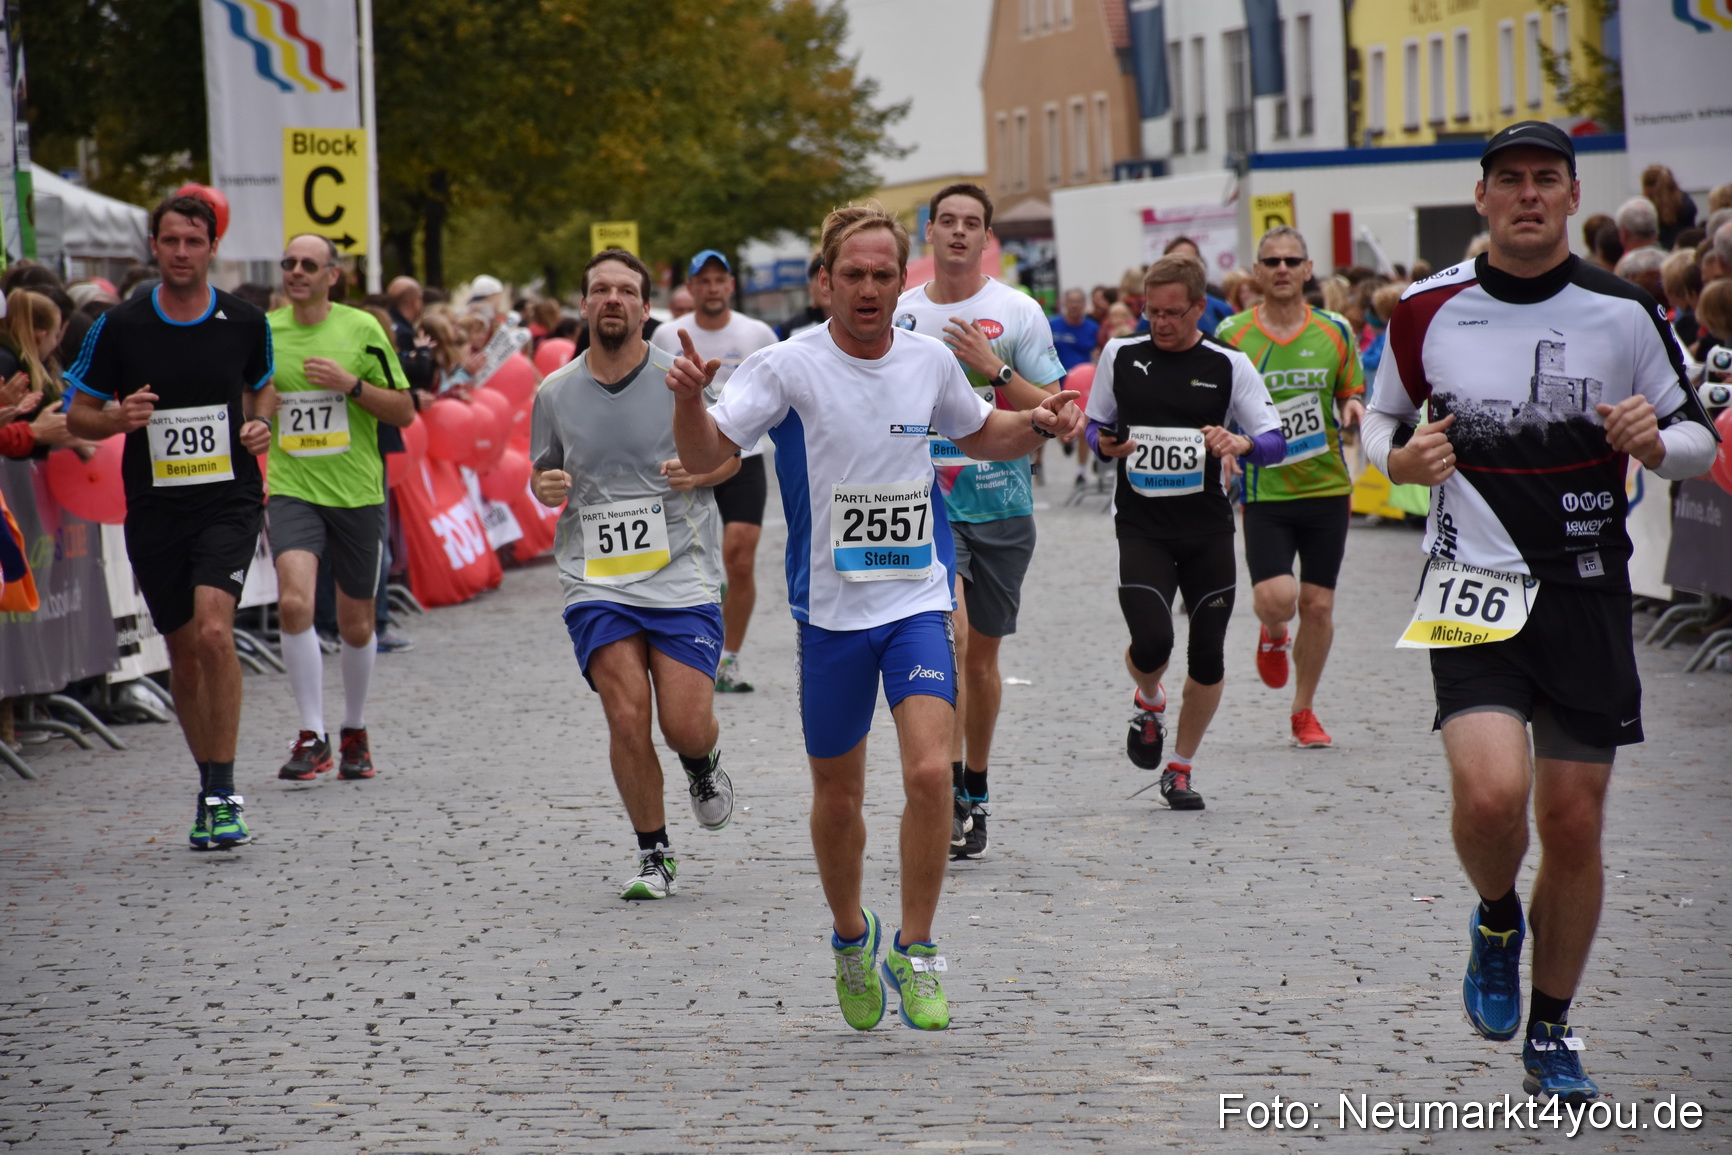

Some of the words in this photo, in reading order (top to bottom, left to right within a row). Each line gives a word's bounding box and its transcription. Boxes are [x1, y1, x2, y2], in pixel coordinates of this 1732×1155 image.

[292, 131, 358, 156] Block
[303, 165, 346, 227] C
[175, 414, 216, 424] Neumarkt
[290, 406, 332, 432] 217
[164, 425, 216, 456] 298
[300, 437, 328, 448] Alfred
[1130, 433, 1154, 442] PARTL
[1155, 434, 1192, 443] Neumarkt
[1134, 444, 1198, 471] 2063
[166, 460, 217, 476] Benjamin
[975, 479, 1009, 490] Stadtlauf
[1144, 476, 1186, 488] Michael
[834, 493, 872, 504] PARTL
[874, 490, 922, 503] Neumarkt
[582, 512, 607, 523] PARTL
[607, 507, 649, 519] Neumarkt
[842, 503, 928, 543] 2557
[598, 519, 651, 554] 512
[864, 551, 910, 566] Stefan
[1429, 561, 1459, 573] PARTL
[1461, 563, 1519, 585] Neumarkt
[1438, 577, 1510, 623] 156
[1430, 625, 1489, 644] Michael
